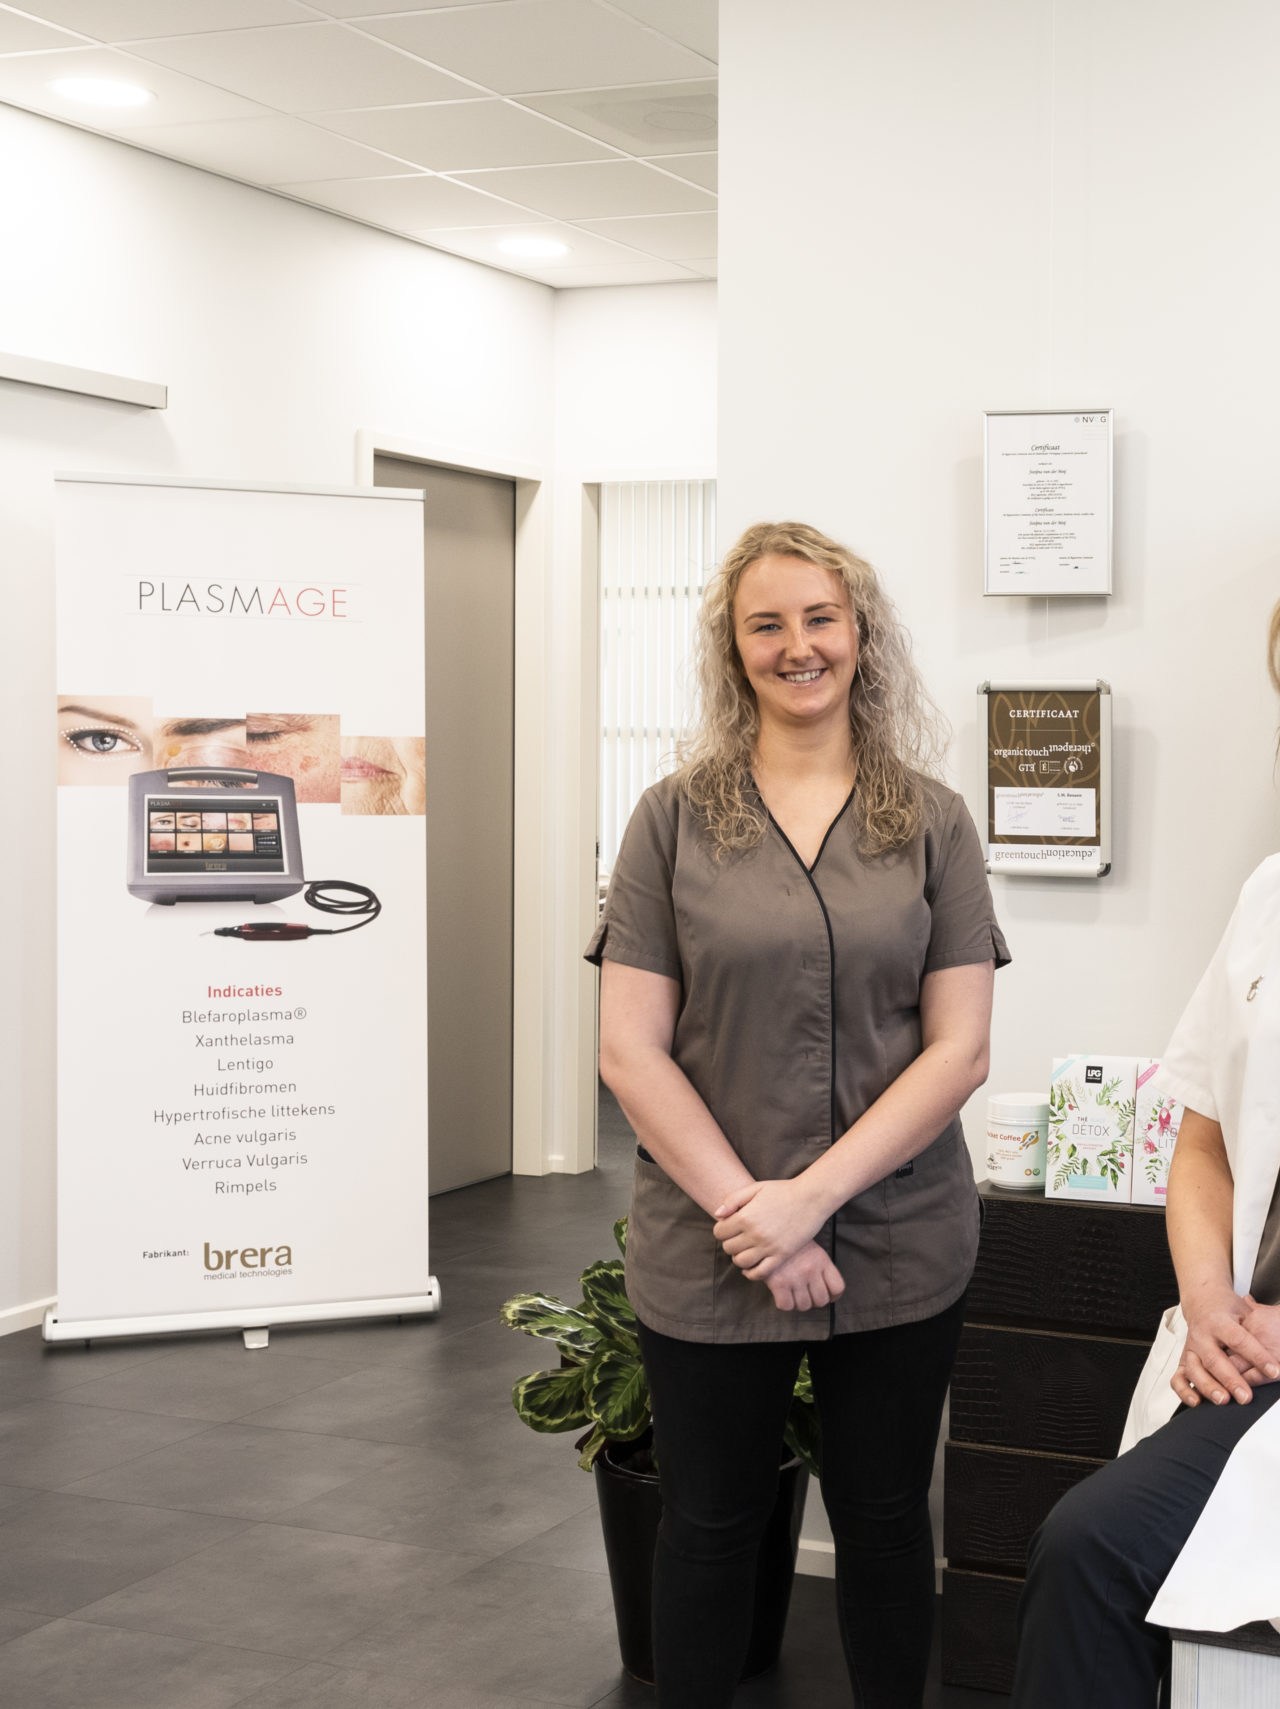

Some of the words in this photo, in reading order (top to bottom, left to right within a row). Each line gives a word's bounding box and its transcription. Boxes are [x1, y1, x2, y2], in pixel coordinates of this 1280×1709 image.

[138, 581, 348, 618] PLASMAGE
[1009, 709, 1080, 719] CERTIFICAAT
[207, 984, 283, 998] Indicaties
[182, 1007, 307, 1025] Blefaroplasma®
[195, 1033, 295, 1048] Xanthelasma
[217, 1058, 274, 1073] Lentigo
[1087, 1069, 1101, 1077] LPG
[194, 1081, 297, 1096] Huidfibromen
[153, 1106, 266, 1125] Hypertrofische
[271, 1103, 336, 1117] littekens
[194, 1132, 232, 1146] Acne
[236, 1129, 297, 1147] vulgaris
[182, 1157, 242, 1170] Verruca
[246, 1152, 308, 1169] Vulgaris
[214, 1179, 277, 1196] Rimpels
[142, 1249, 190, 1259] Fabrikant:
[203, 1242, 293, 1271] brera
[203, 1271, 238, 1281] medical
[239, 1266, 293, 1281] technologies
